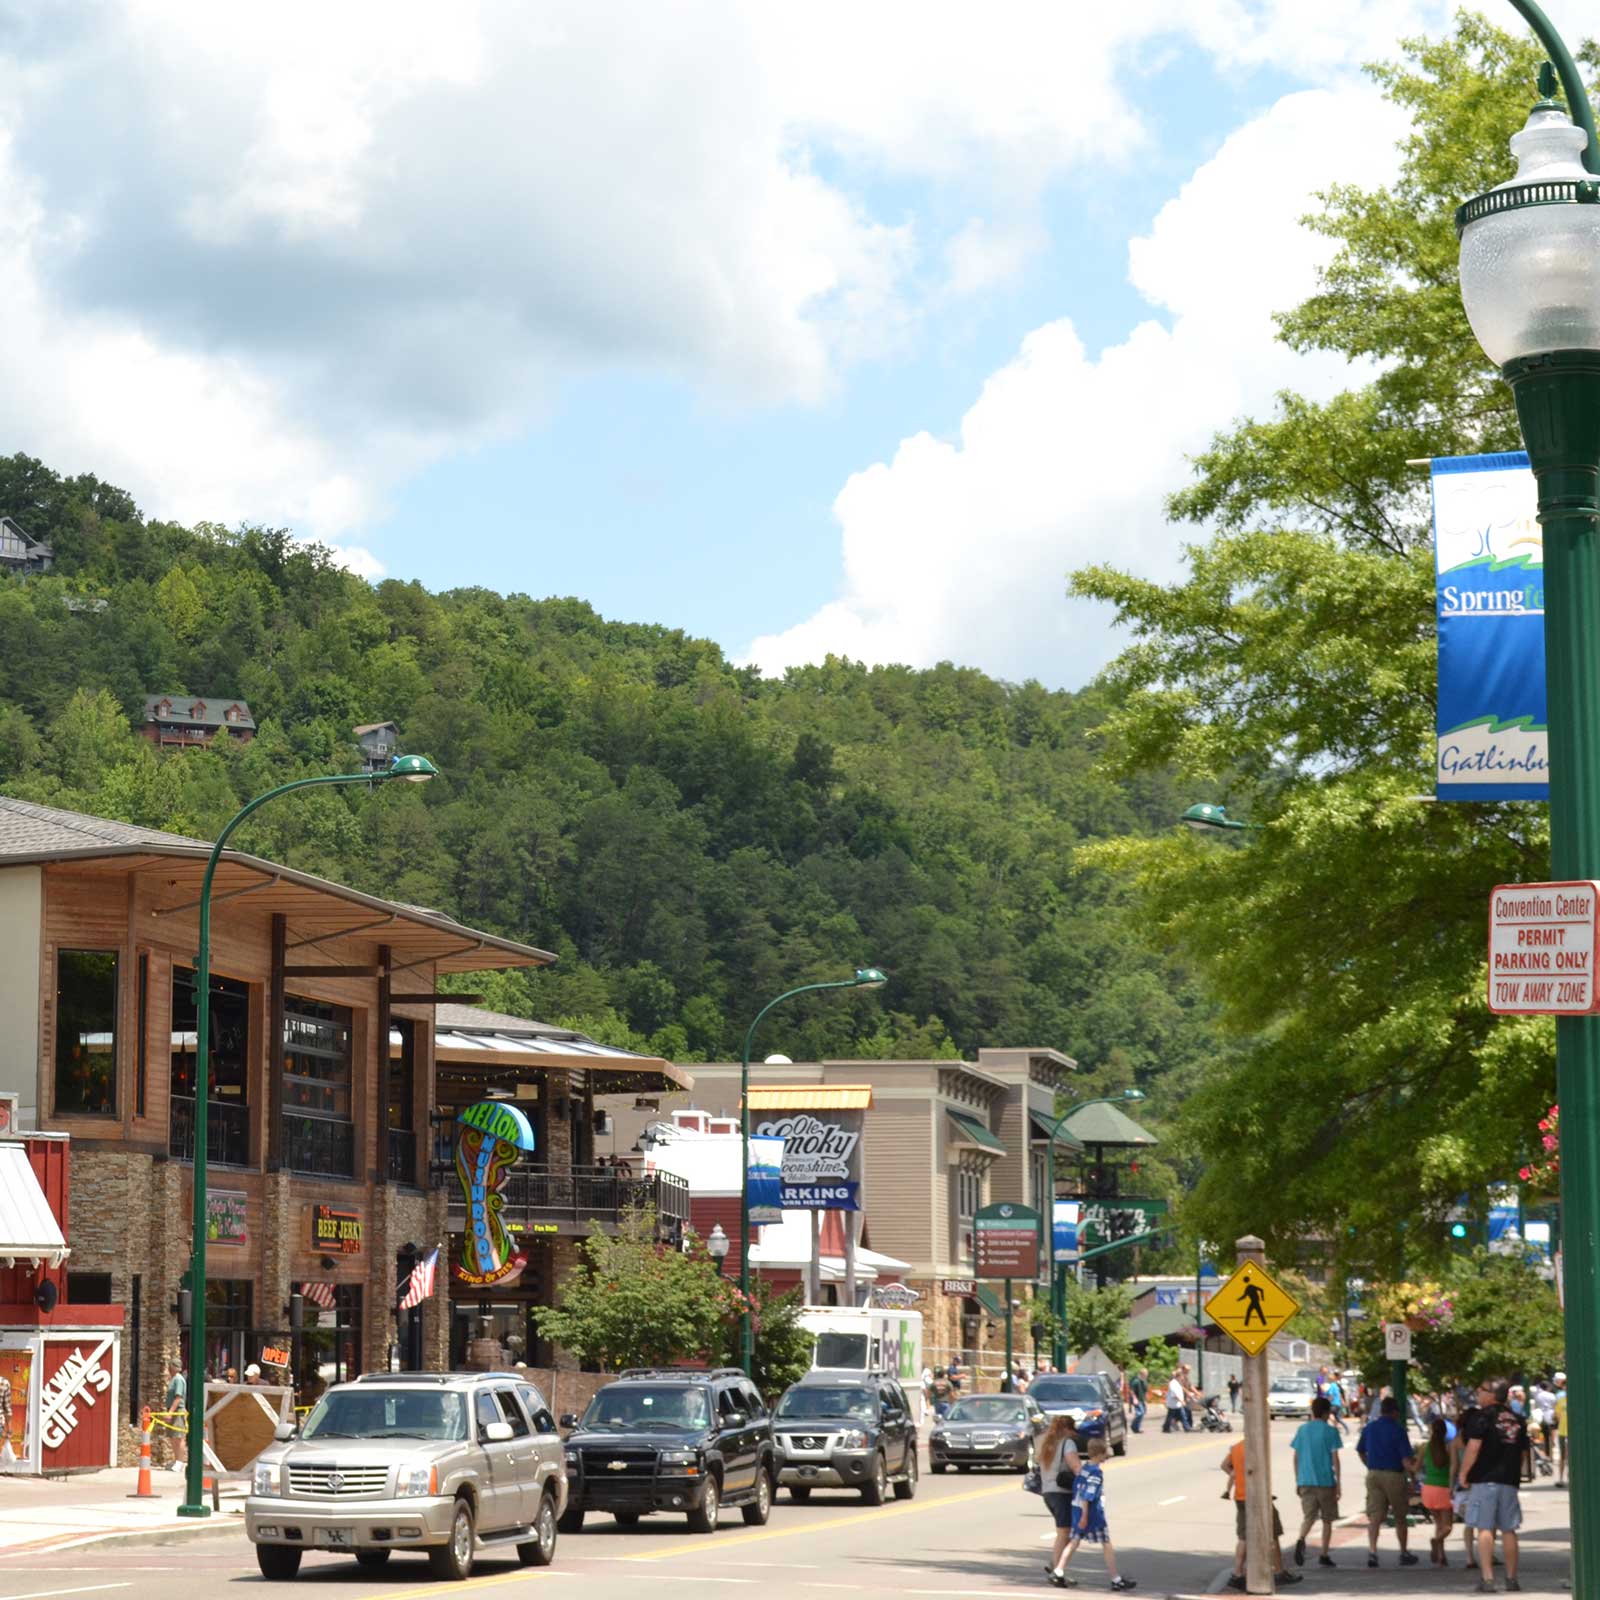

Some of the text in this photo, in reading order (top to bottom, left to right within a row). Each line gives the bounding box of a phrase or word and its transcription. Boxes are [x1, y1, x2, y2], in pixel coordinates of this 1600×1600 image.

[1443, 584, 1545, 614] Springfe
[1440, 745, 1549, 776] Gatlinbu
[1495, 894, 1590, 918] Convention Center
[1517, 928, 1566, 946] PERMIT
[1494, 951, 1588, 969] PARKING ONLY
[1496, 982, 1587, 1003] TOW AWAY ZONE
[463, 1103, 520, 1143] MELLOW
[793, 1117, 824, 1135] Ole
[782, 1160, 846, 1173] oonshine
[471, 1134, 496, 1273] MUSHROOM
[780, 1187, 849, 1199] RKING
[319, 1205, 331, 1219] THE
[318, 1219, 364, 1241] BEEF JERKY
[457, 1262, 513, 1284] KING OF PIES
[944, 1280, 975, 1292] BB&T
[264, 1347, 288, 1365] OPEN
[42, 1362, 111, 1449] GIFTS
